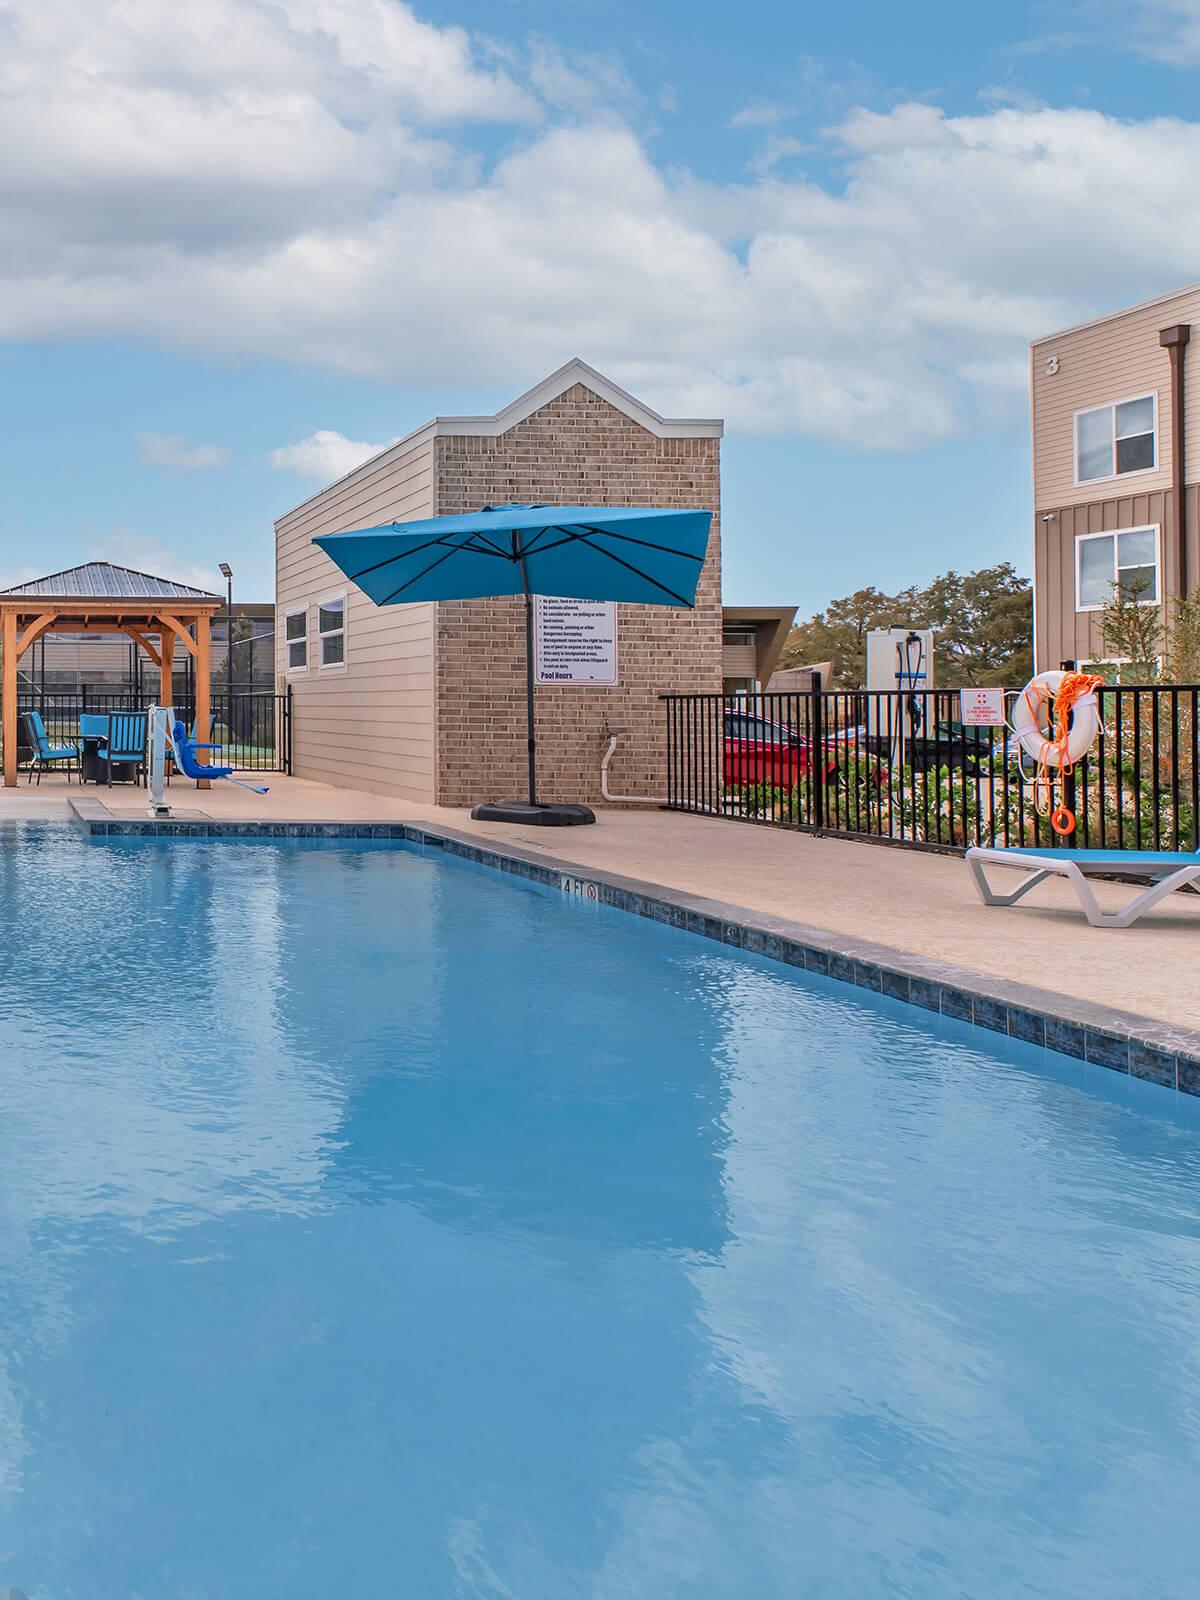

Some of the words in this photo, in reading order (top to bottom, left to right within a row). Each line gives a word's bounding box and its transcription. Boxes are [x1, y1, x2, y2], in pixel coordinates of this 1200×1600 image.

[1046, 356, 1058, 375] 3
[564, 879, 570, 893] 4
[574, 879, 584, 897] FT
